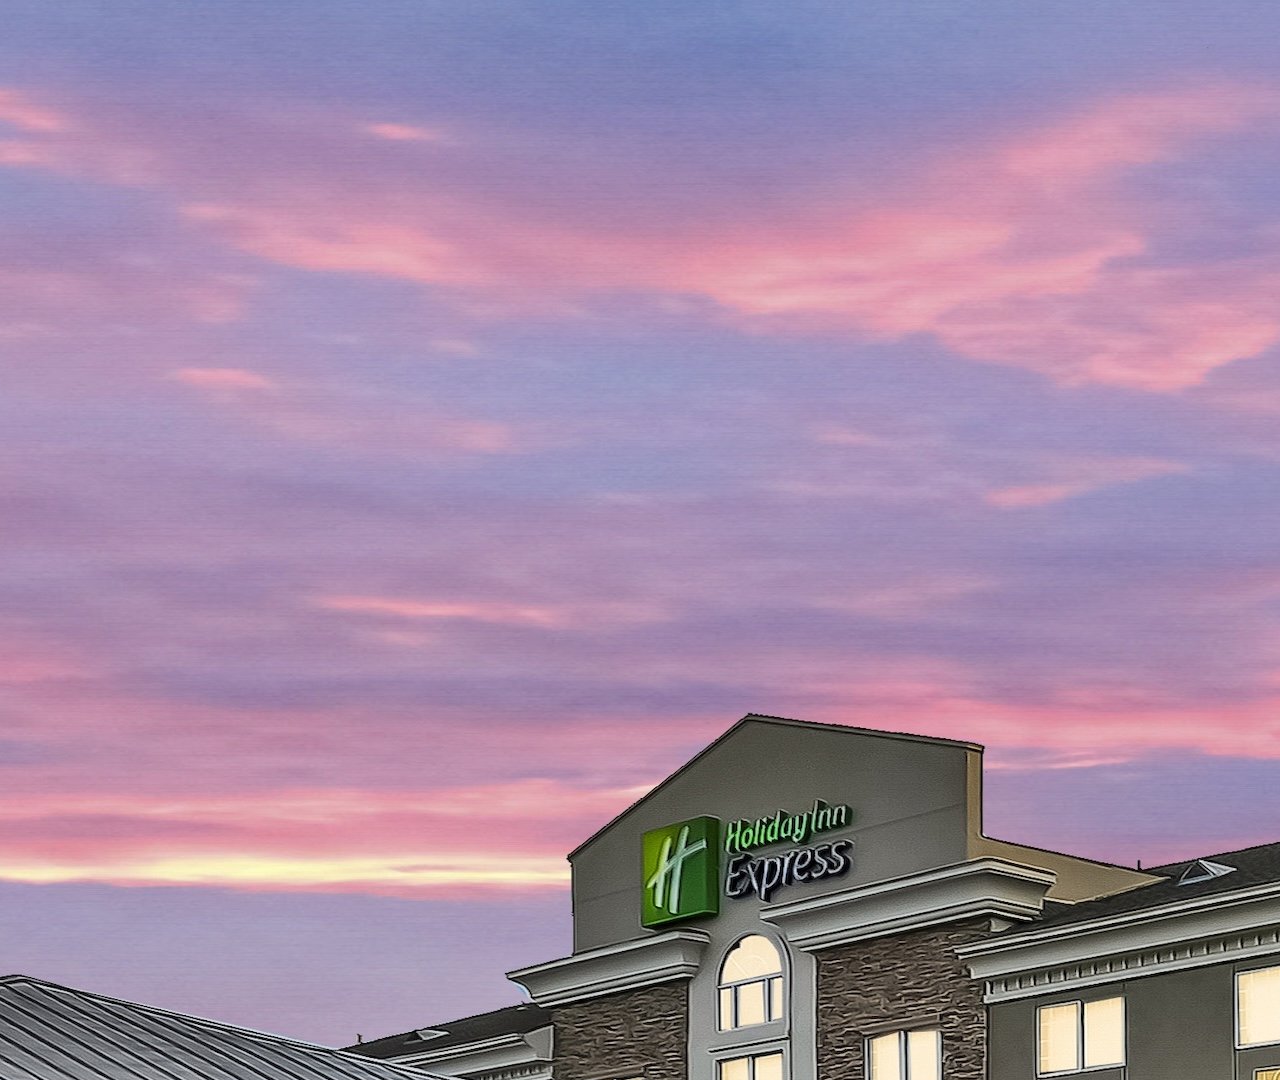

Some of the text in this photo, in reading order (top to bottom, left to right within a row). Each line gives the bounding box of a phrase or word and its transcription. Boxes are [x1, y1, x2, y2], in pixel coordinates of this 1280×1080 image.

[725, 798, 851, 854] Holiday Inn
[725, 839, 854, 902] Express
